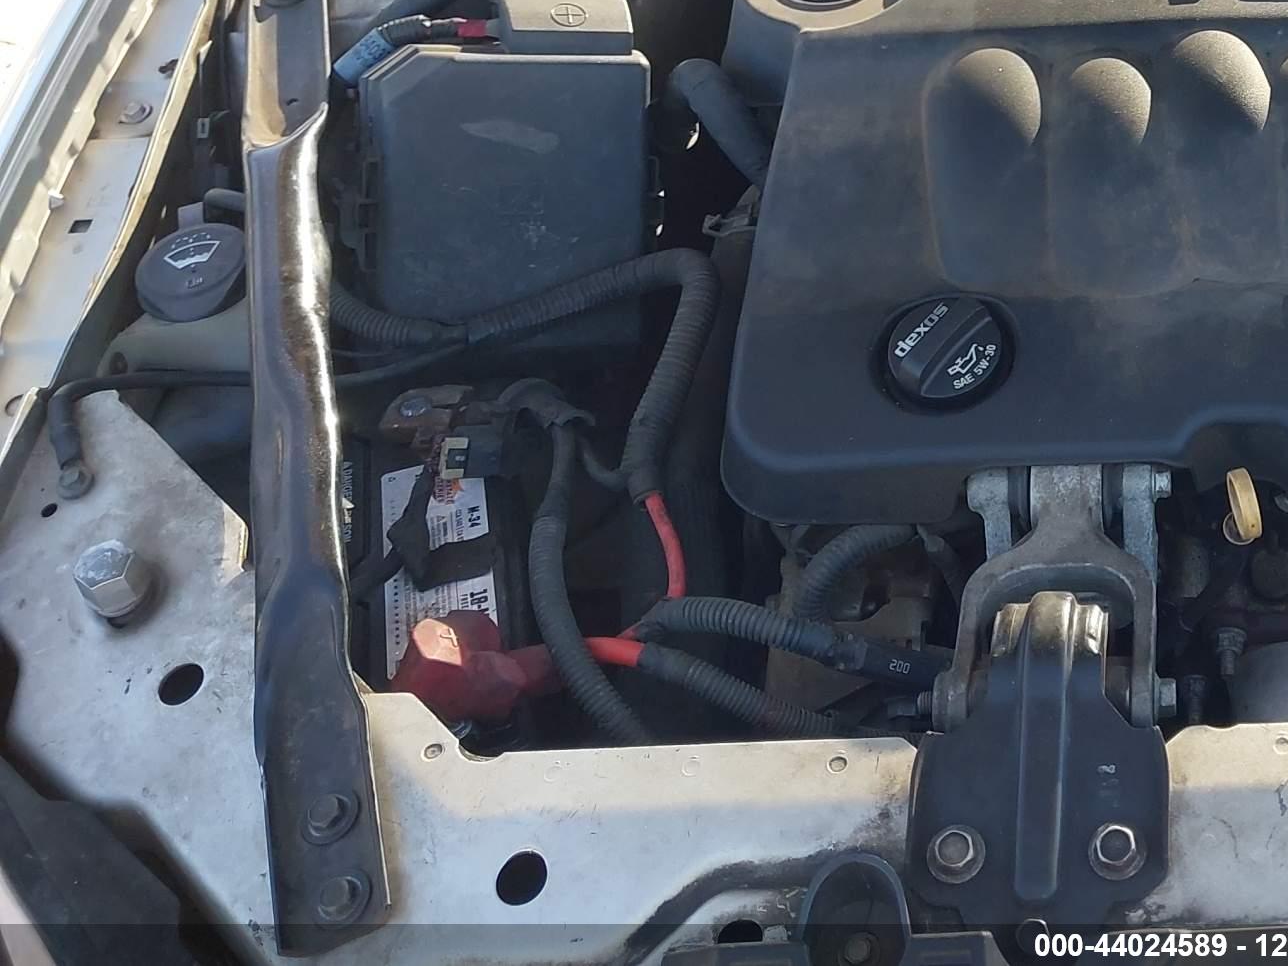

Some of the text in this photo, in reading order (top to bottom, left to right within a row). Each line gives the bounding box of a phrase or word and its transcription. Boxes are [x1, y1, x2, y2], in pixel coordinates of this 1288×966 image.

[894, 302, 949, 358] dexos
[953, 344, 997, 390] SAE 5W-30
[889, 659, 911, 674] 200
